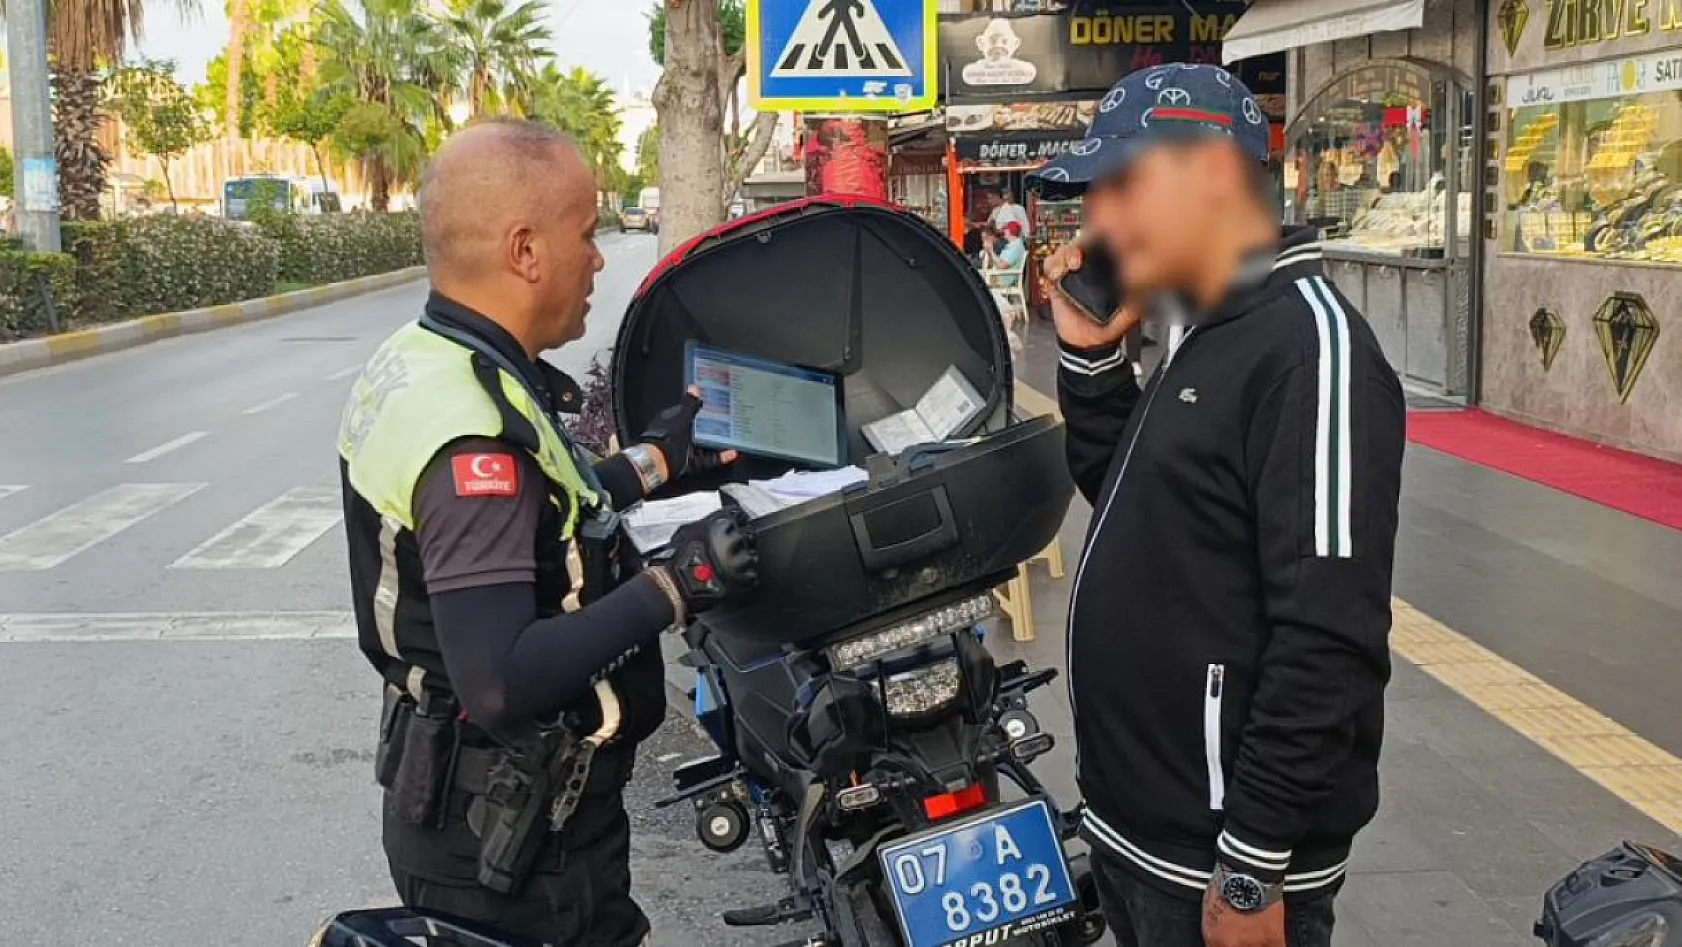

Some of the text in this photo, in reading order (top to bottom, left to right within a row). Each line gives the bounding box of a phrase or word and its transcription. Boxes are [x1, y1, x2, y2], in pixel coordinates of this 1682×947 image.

[1070, 10, 1174, 44] DÖNER
[894, 823, 1022, 894] 07 A
[941, 863, 1056, 932] 8382
